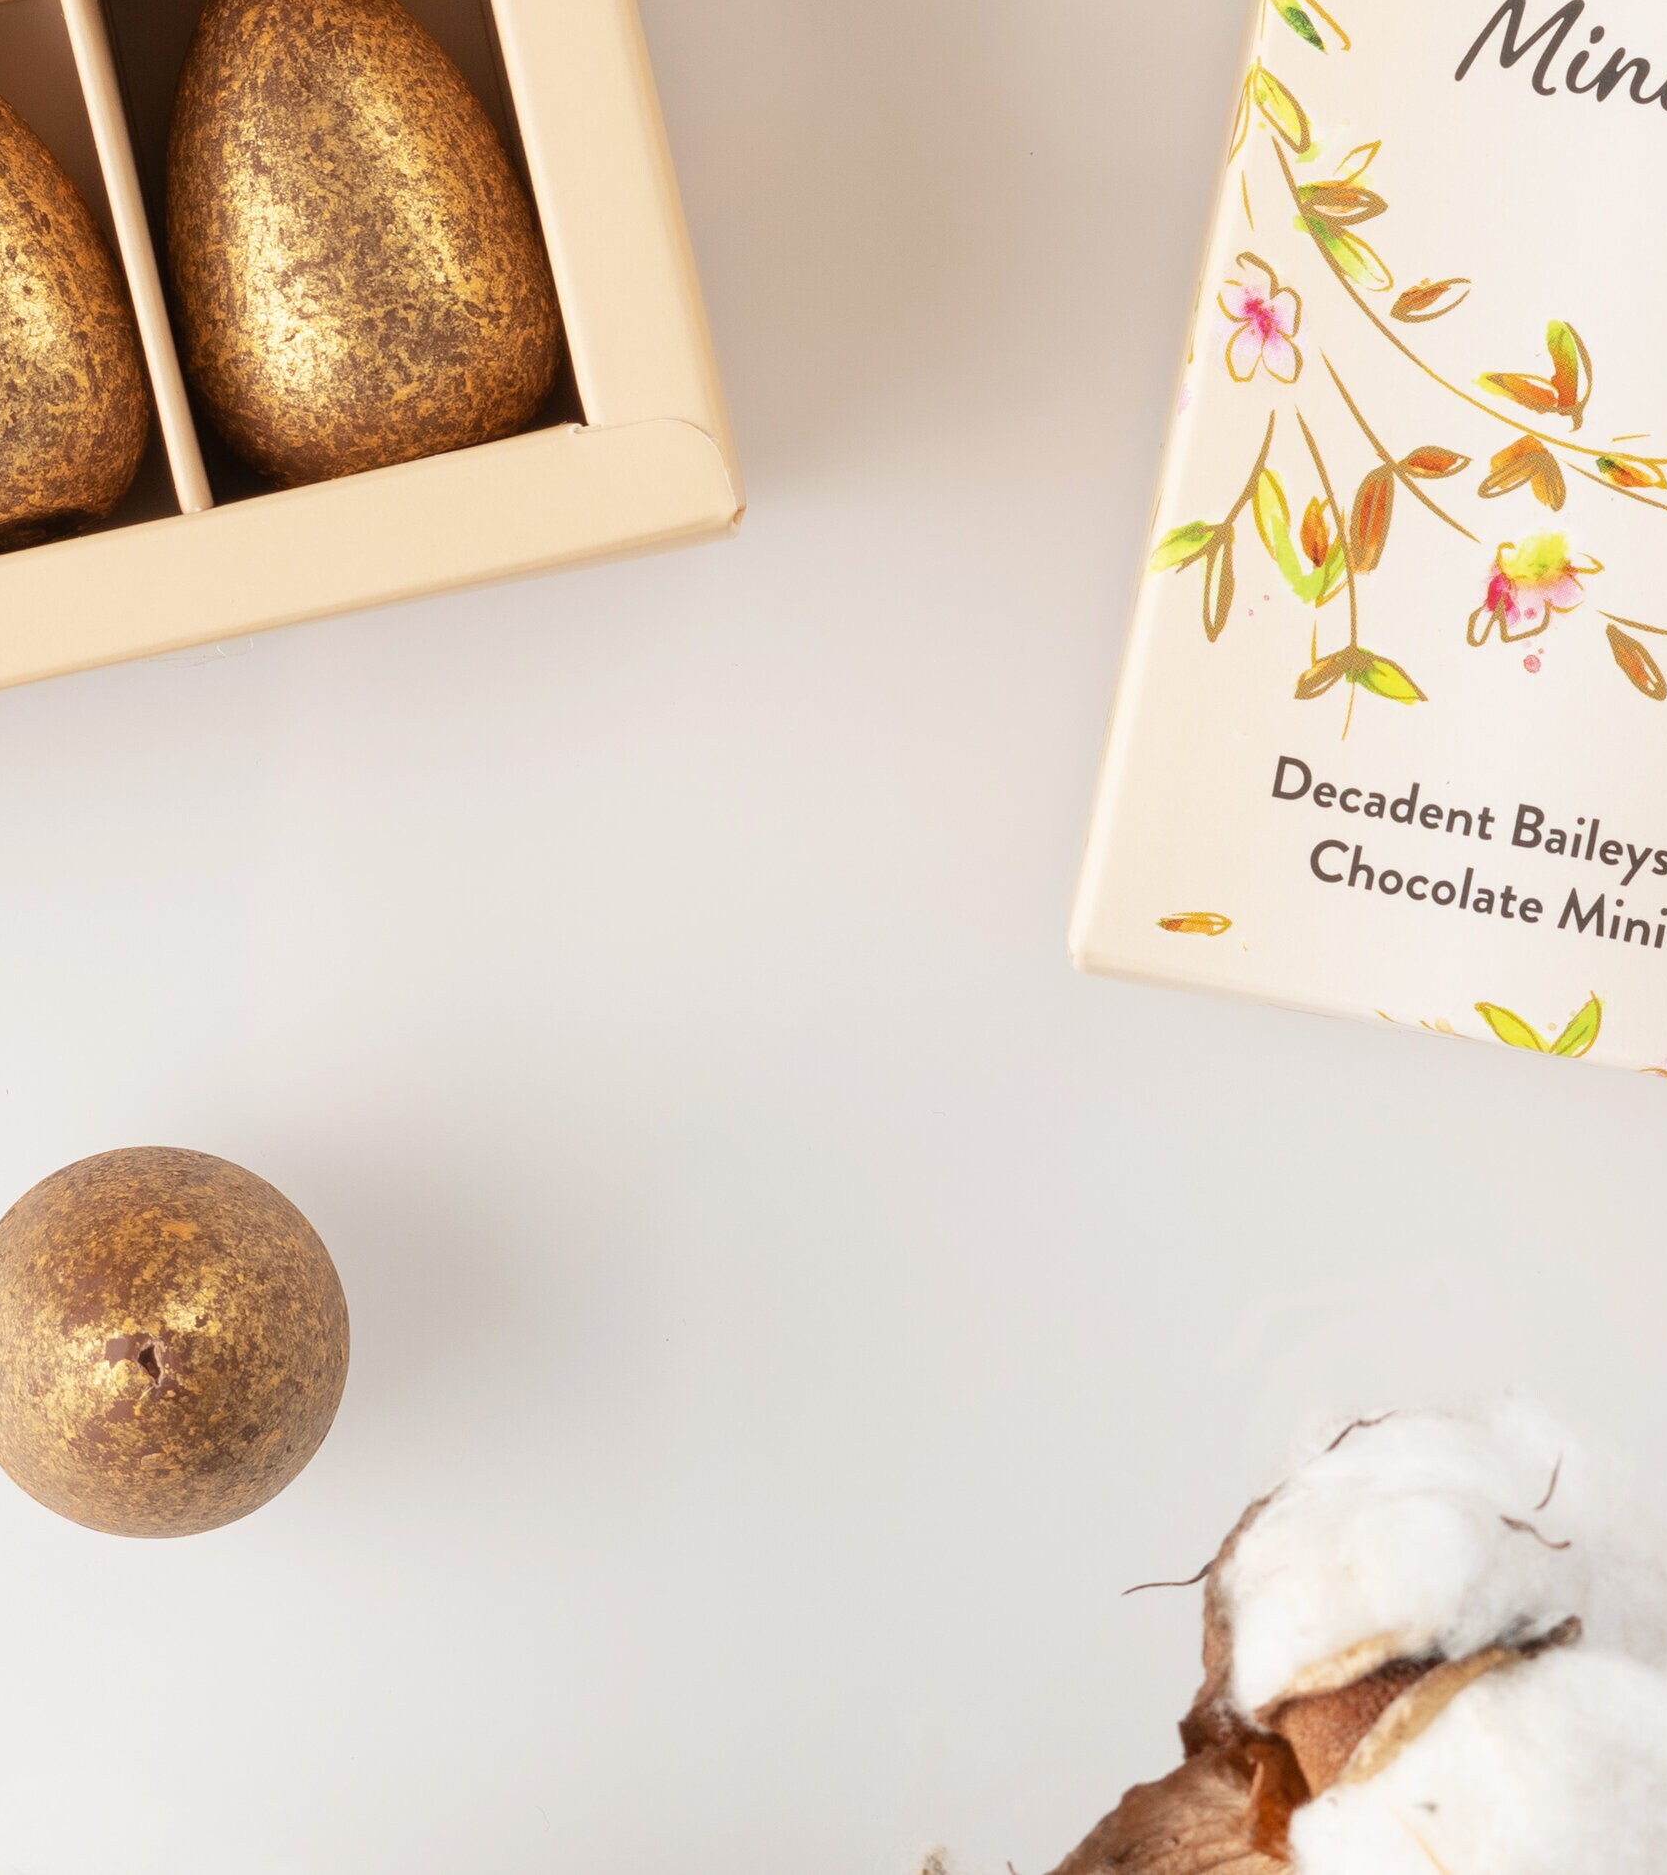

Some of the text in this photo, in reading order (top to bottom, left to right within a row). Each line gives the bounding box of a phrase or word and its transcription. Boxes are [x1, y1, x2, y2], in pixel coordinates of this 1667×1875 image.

[1272, 756, 1494, 840] Decadent
[1311, 840, 1542, 923] Chocolate
[1558, 888, 1667, 948] Mini
